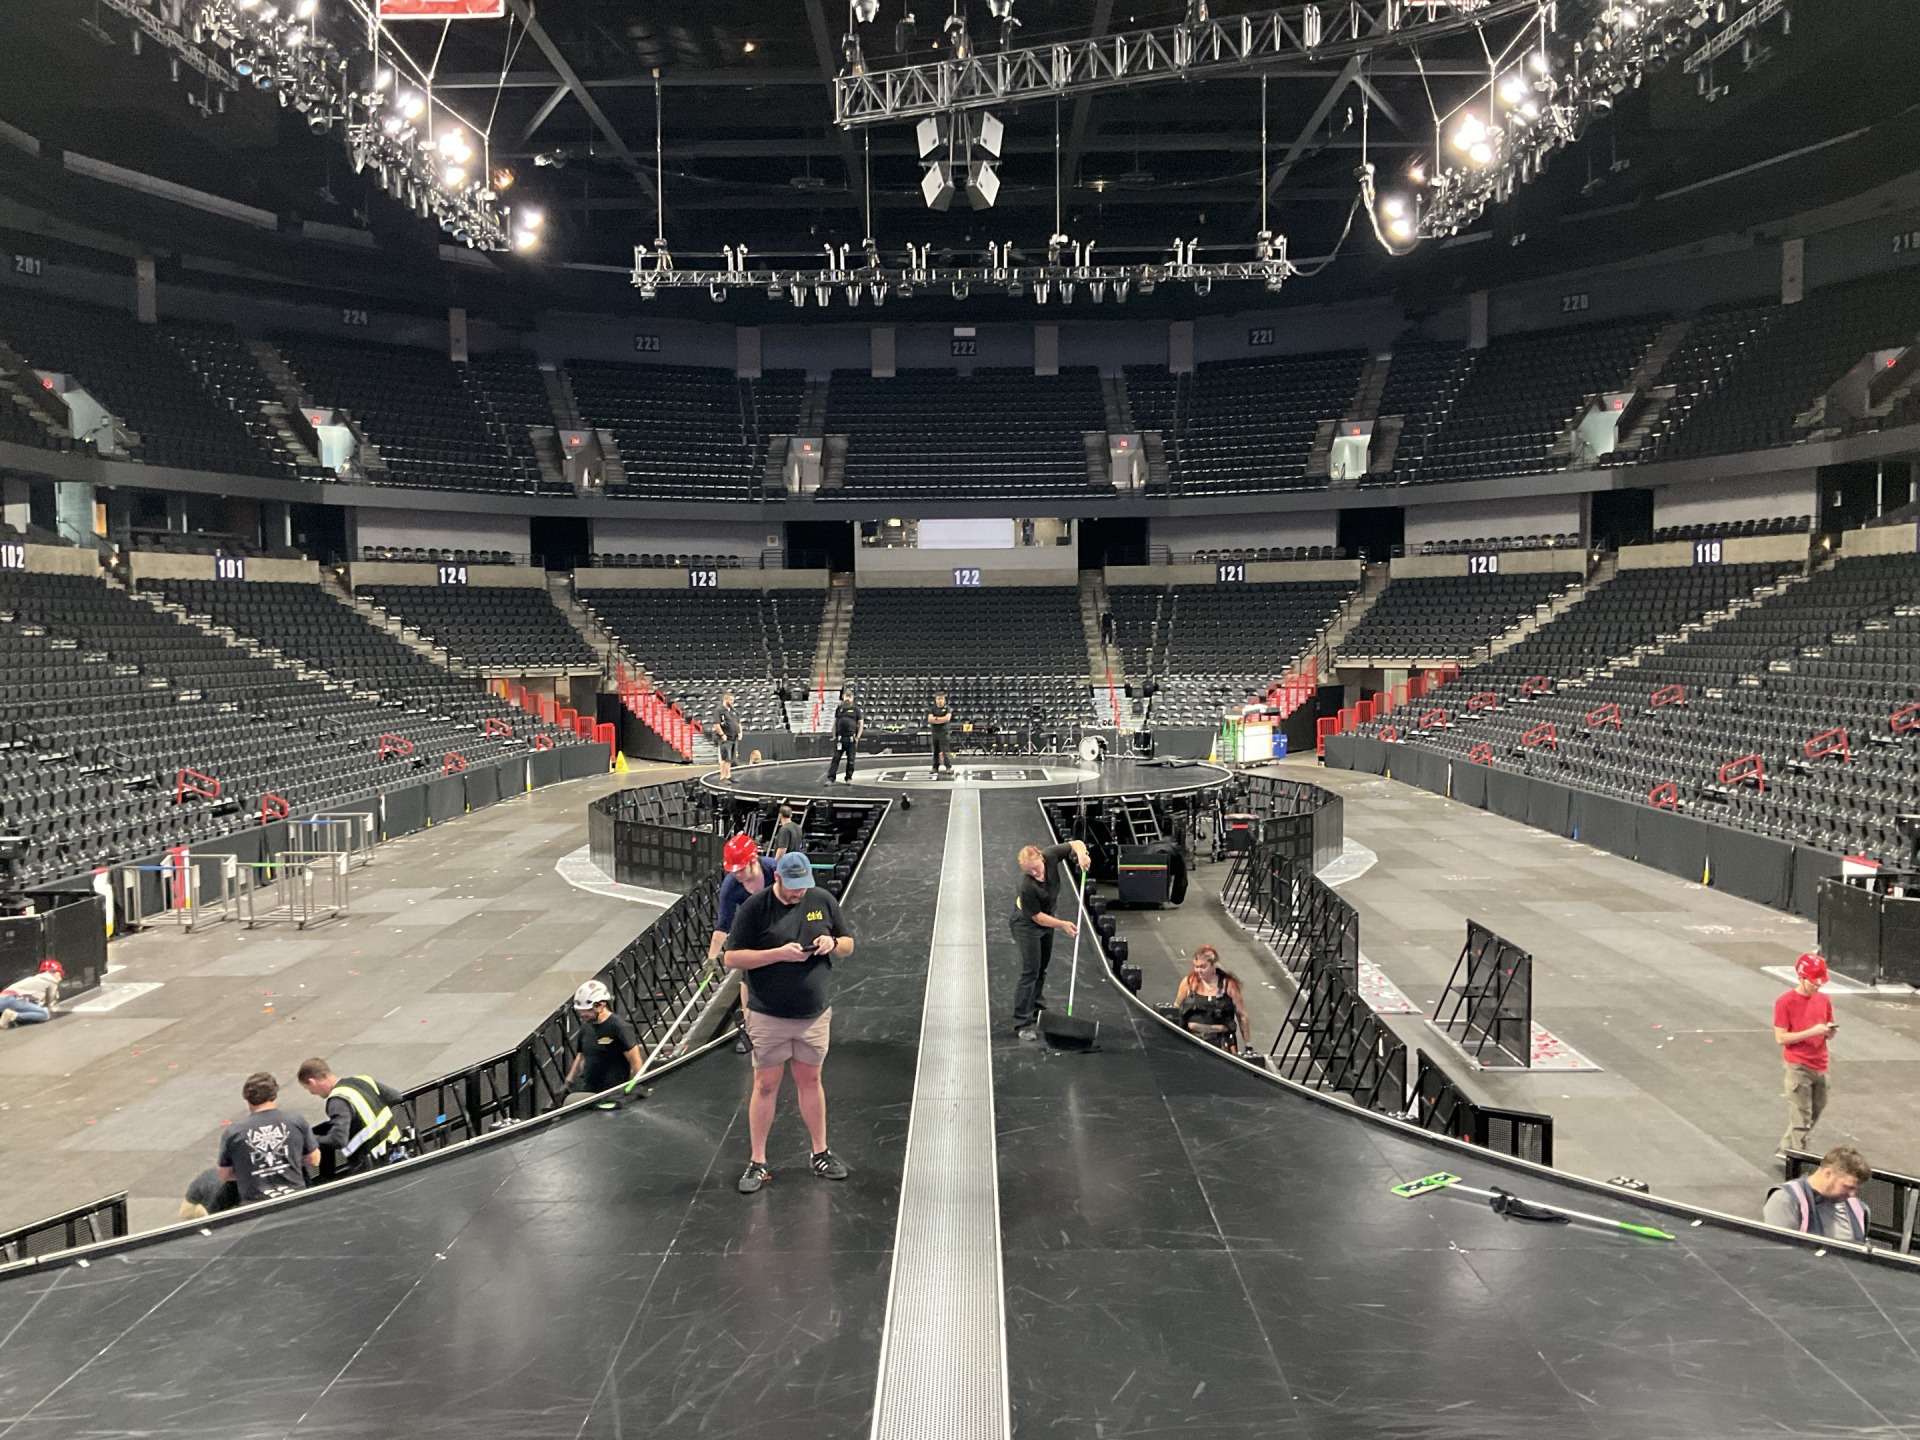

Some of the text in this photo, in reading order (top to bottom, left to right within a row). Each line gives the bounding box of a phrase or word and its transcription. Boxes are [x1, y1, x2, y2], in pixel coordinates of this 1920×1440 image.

[16, 255, 41, 274] 201
[1564, 295, 1589, 312] 220
[343, 310, 367, 324] 224
[637, 337, 660, 351] 223
[1253, 330, 1273, 345] 221
[953, 342, 976, 355] 222
[1, 545, 25, 568] 102
[1697, 543, 1720, 563] 119
[218, 559, 243, 578] 101
[1220, 565, 1243, 582] 121
[1471, 557, 1497, 574] 120
[440, 567, 467, 585] 124
[691, 571, 717, 587] 123
[954, 570, 980, 585] 122
